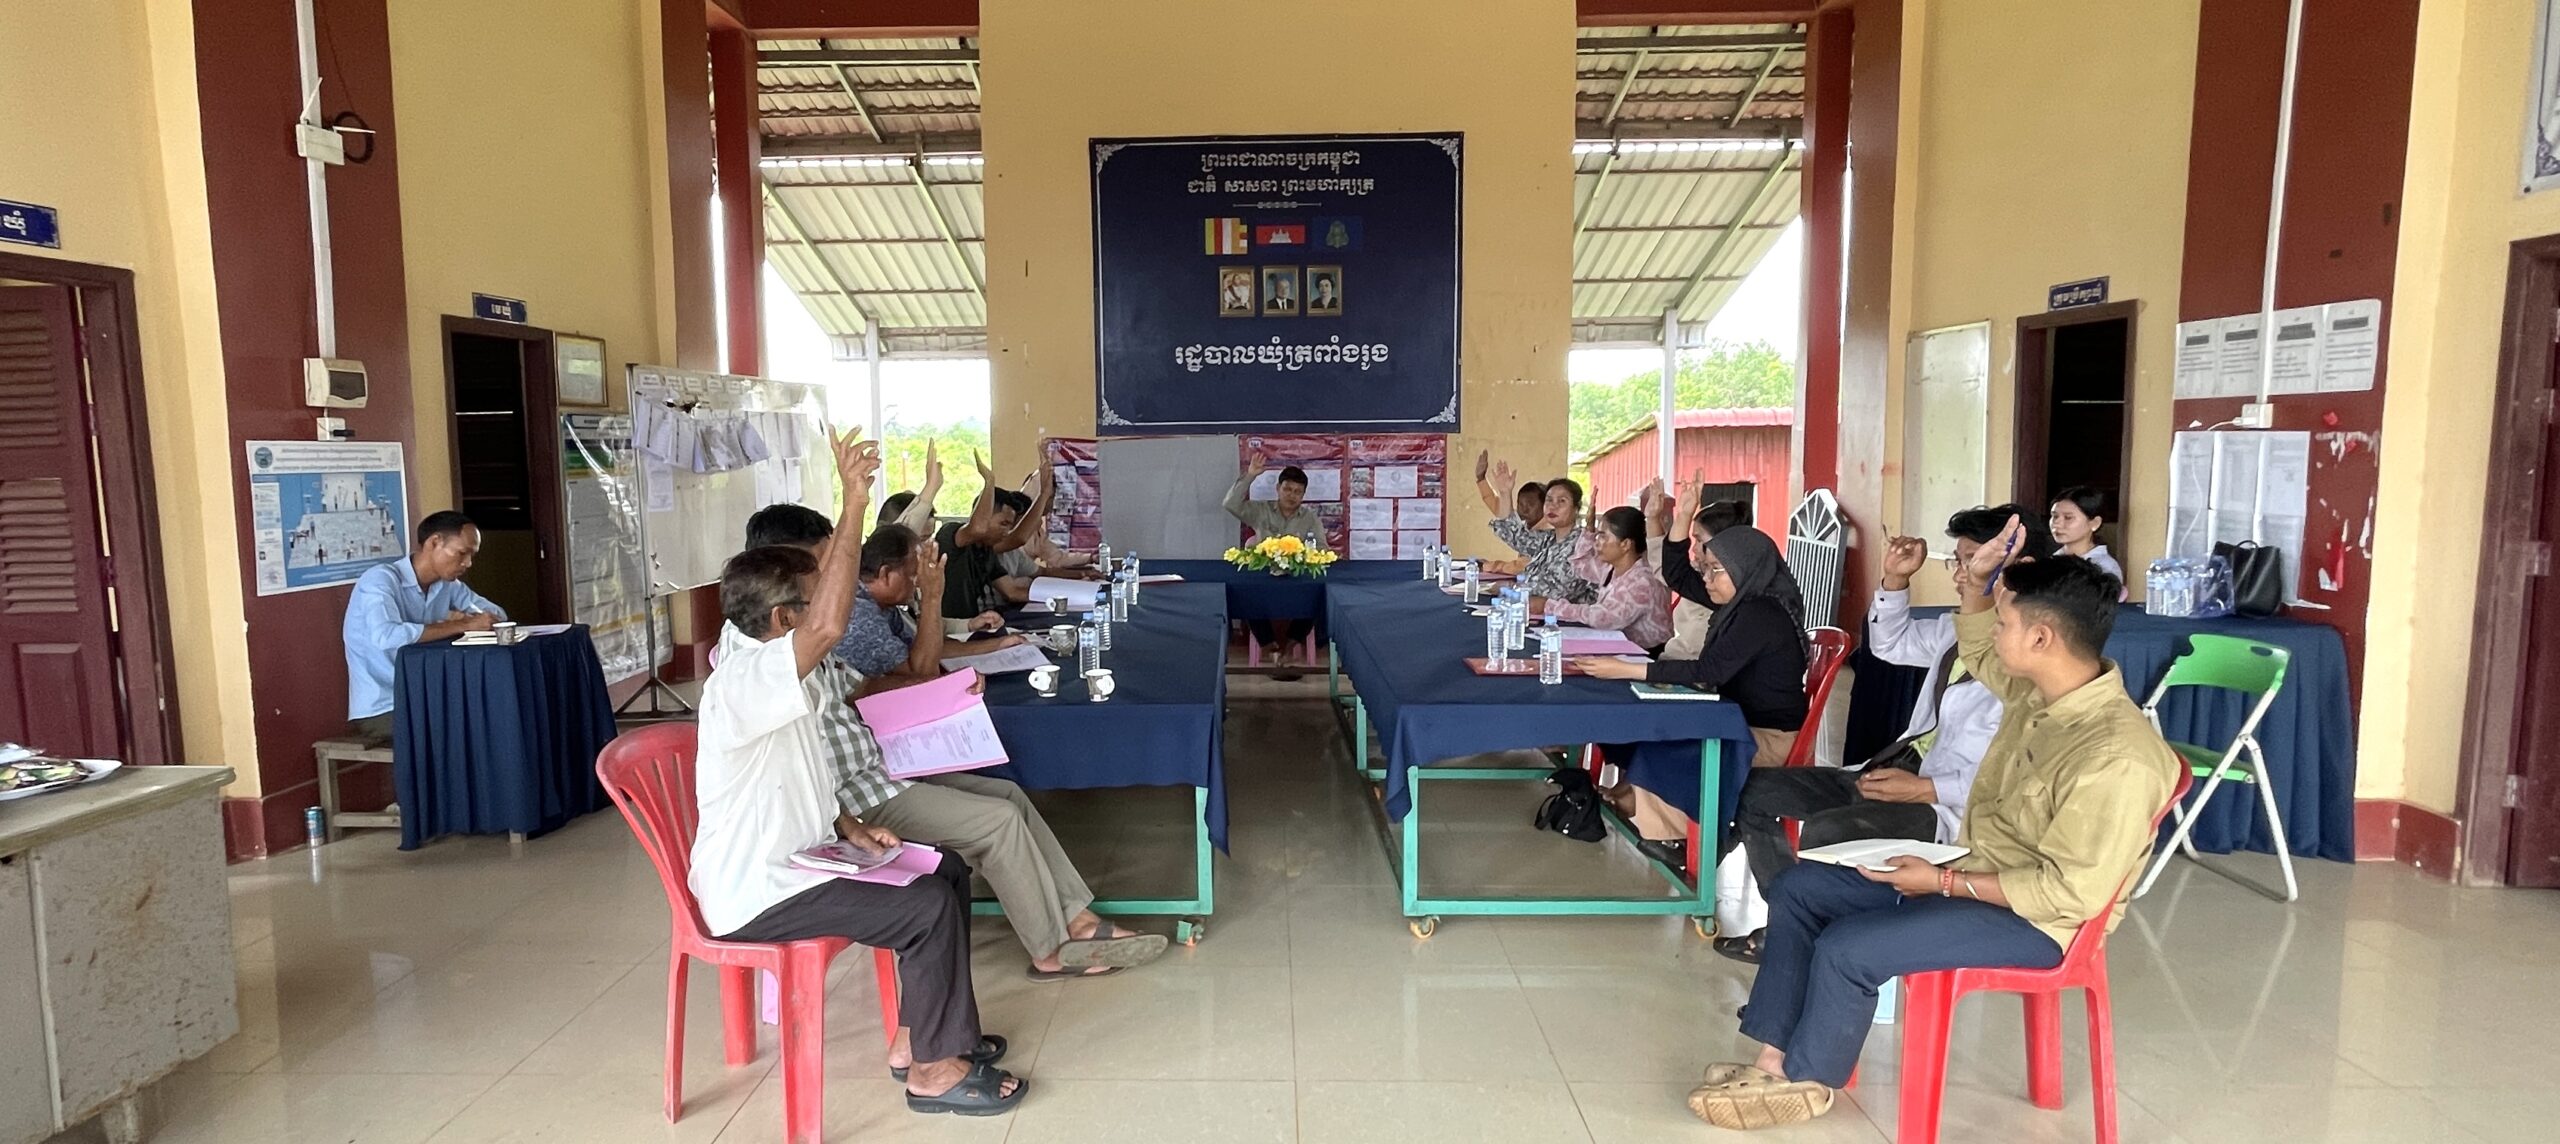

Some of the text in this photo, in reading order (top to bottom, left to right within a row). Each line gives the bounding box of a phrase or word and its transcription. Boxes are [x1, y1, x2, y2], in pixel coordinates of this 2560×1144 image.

[1201, 150, 1360, 175] ព្រះរាជាណាចក្រកម្ពុជា
[1187, 174, 1375, 197] ជាតិ សាសនា ព្រះមហាក្សត្រ
[1175, 334, 1390, 373] រដ្ឋបាលឃុំត្រពាំងរូង
